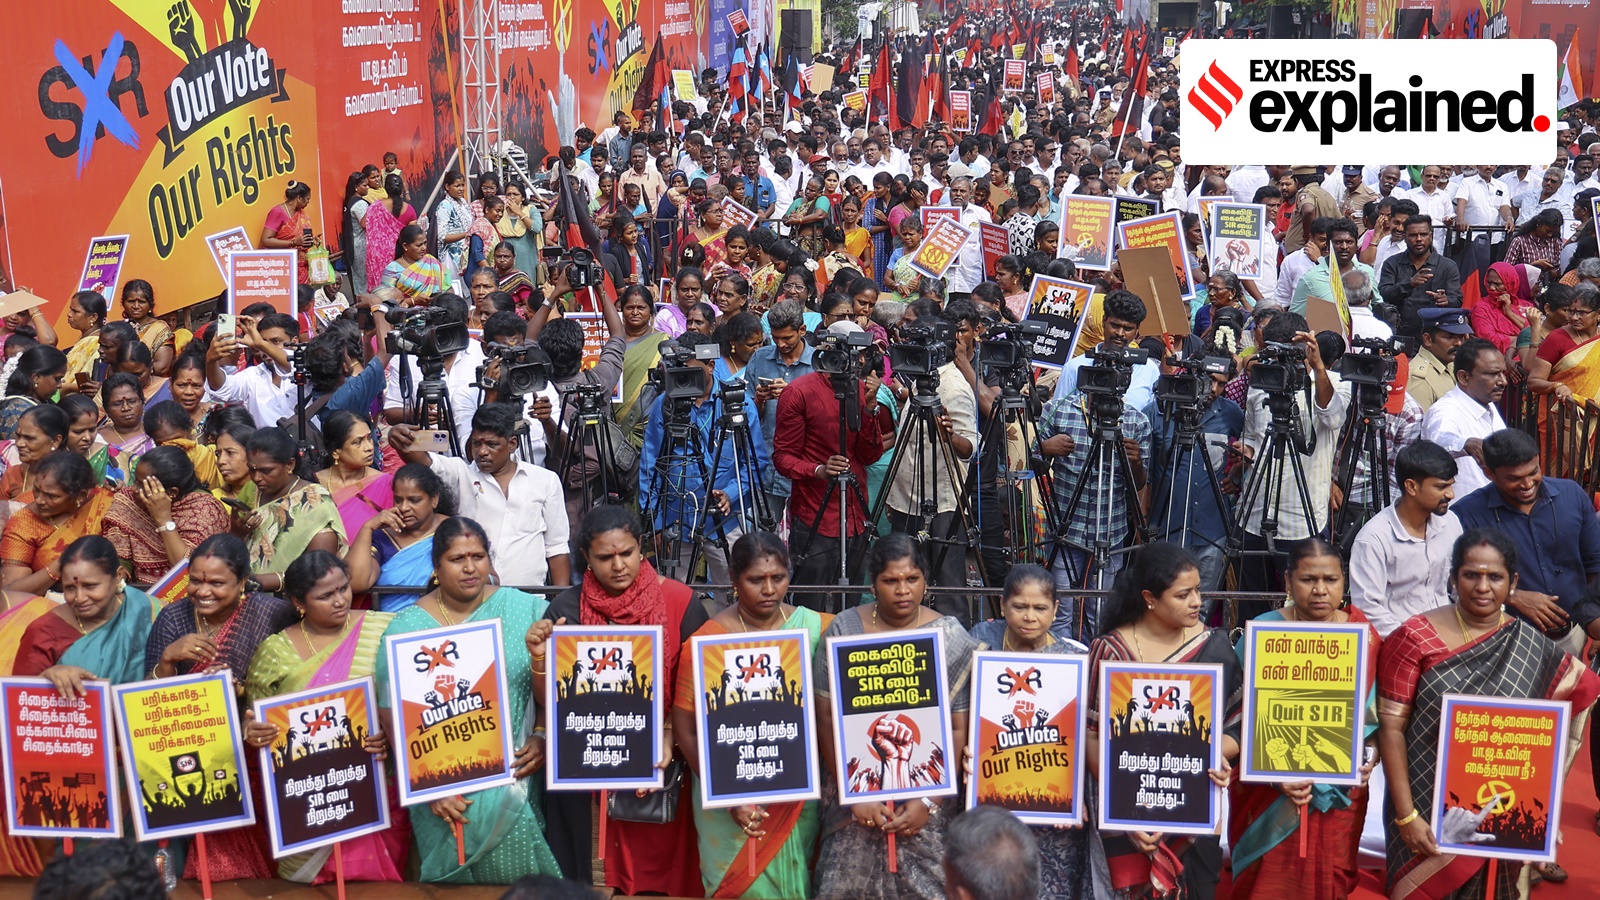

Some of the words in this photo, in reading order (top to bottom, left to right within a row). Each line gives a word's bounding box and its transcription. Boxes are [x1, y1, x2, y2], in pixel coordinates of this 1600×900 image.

[615, 38, 627, 66] Our
[627, 23, 642, 55] Vote
[170, 68, 215, 132] Our
[215, 43, 270, 104] Vote
[610, 83, 623, 126] Our
[624, 59, 646, 104] Right
[149, 161, 204, 260] Our
[206, 114, 295, 205] Rights
[1265, 633, 1292, 653] என்
[587, 647, 623, 671] SIR
[735, 653, 771, 680] SIR
[1262, 660, 1289, 680] என்
[858, 676, 884, 691] SIR
[886, 675, 919, 689] யை
[1143, 685, 1180, 710] SIR
[300, 706, 338, 735] SIR
[422, 702, 448, 726] Our
[448, 694, 483, 716] Vote
[566, 711, 605, 732] நிறுத்து
[606, 711, 646, 731] நிறுத்து
[1272, 703, 1304, 723] Quit
[1309, 704, 1343, 722] SIR
[410, 733, 438, 760] Our
[442, 715, 496, 743] Rights
[586, 733, 602, 746] SIR
[603, 735, 626, 746] யை
[717, 723, 757, 744] நிறுத்து
[758, 720, 798, 741] நிறுத்து
[998, 731, 1024, 748] Our
[1024, 727, 1059, 743] Vote
[739, 745, 755, 759] SIR
[756, 745, 778, 758] யை
[982, 757, 1010, 779] Our
[1015, 748, 1069, 772] Rights
[1118, 750, 1160, 772] நிறுத்து
[1161, 752, 1203, 774] நிறுத்து
[285, 774, 326, 797] நிறுத்து
[327, 764, 367, 787] நிறுத்து
[1140, 774, 1156, 788] SIR
[1158, 777, 1181, 789] யை
[308, 792, 325, 808] SIR
[326, 788, 349, 803] யை
